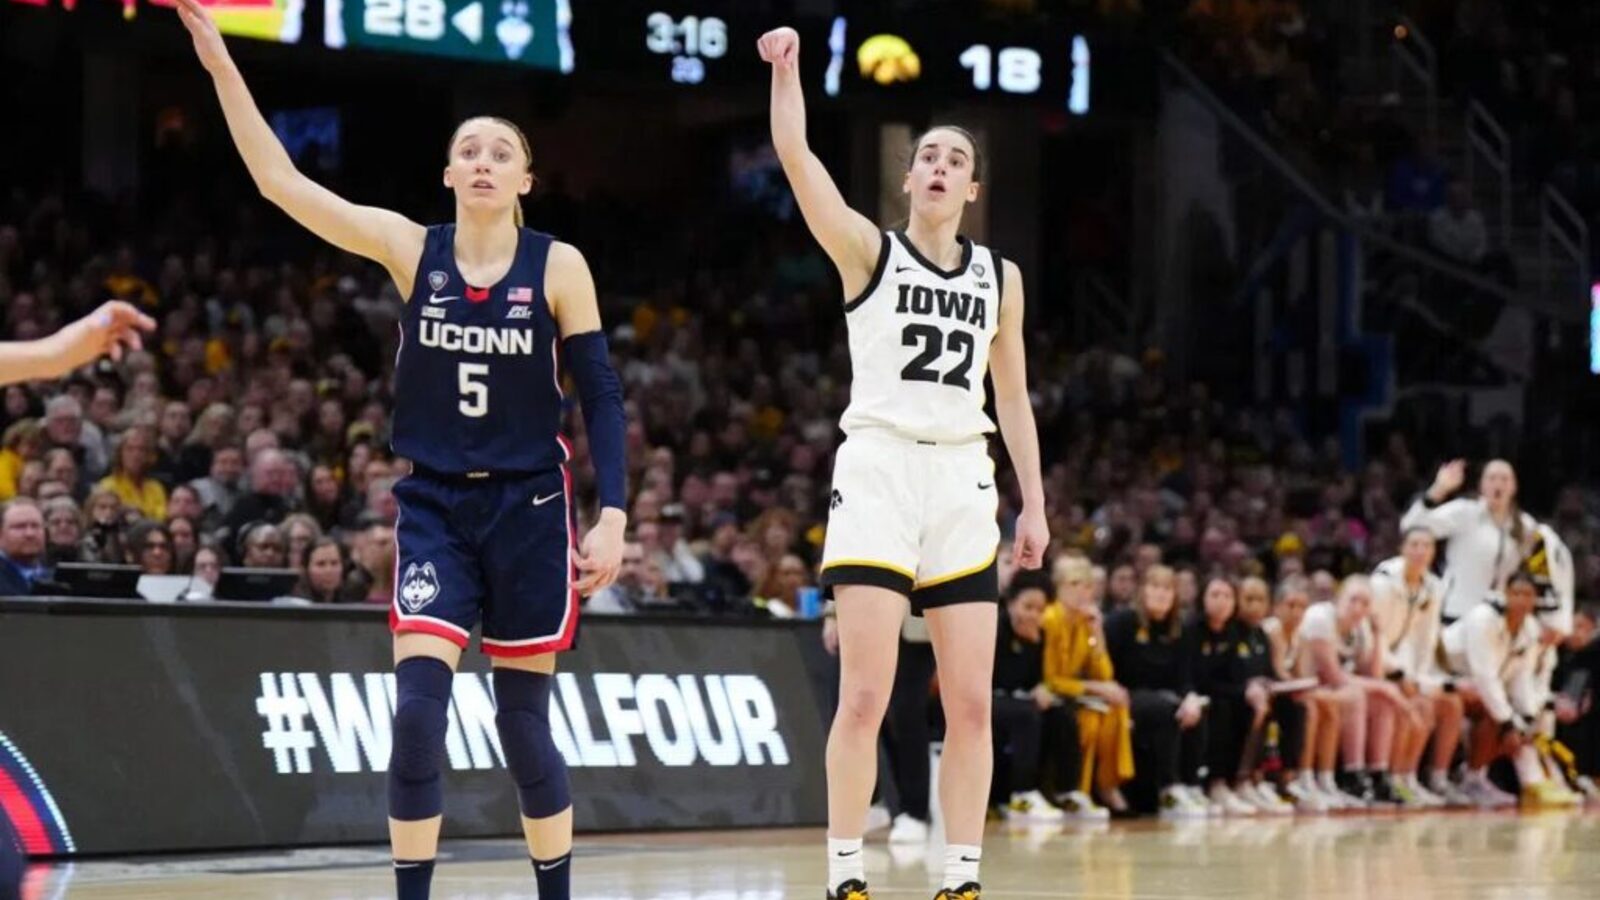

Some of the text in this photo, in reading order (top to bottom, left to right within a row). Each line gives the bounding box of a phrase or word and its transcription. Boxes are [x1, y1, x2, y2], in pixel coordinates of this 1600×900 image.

[364, 0, 446, 40] 28
[646, 12, 728, 58] 3:16
[959, 44, 1041, 93] 18
[895, 284, 986, 330] IOWA
[419, 319, 533, 355] UCONN
[901, 322, 974, 391] 22
[458, 361, 489, 418] 5
